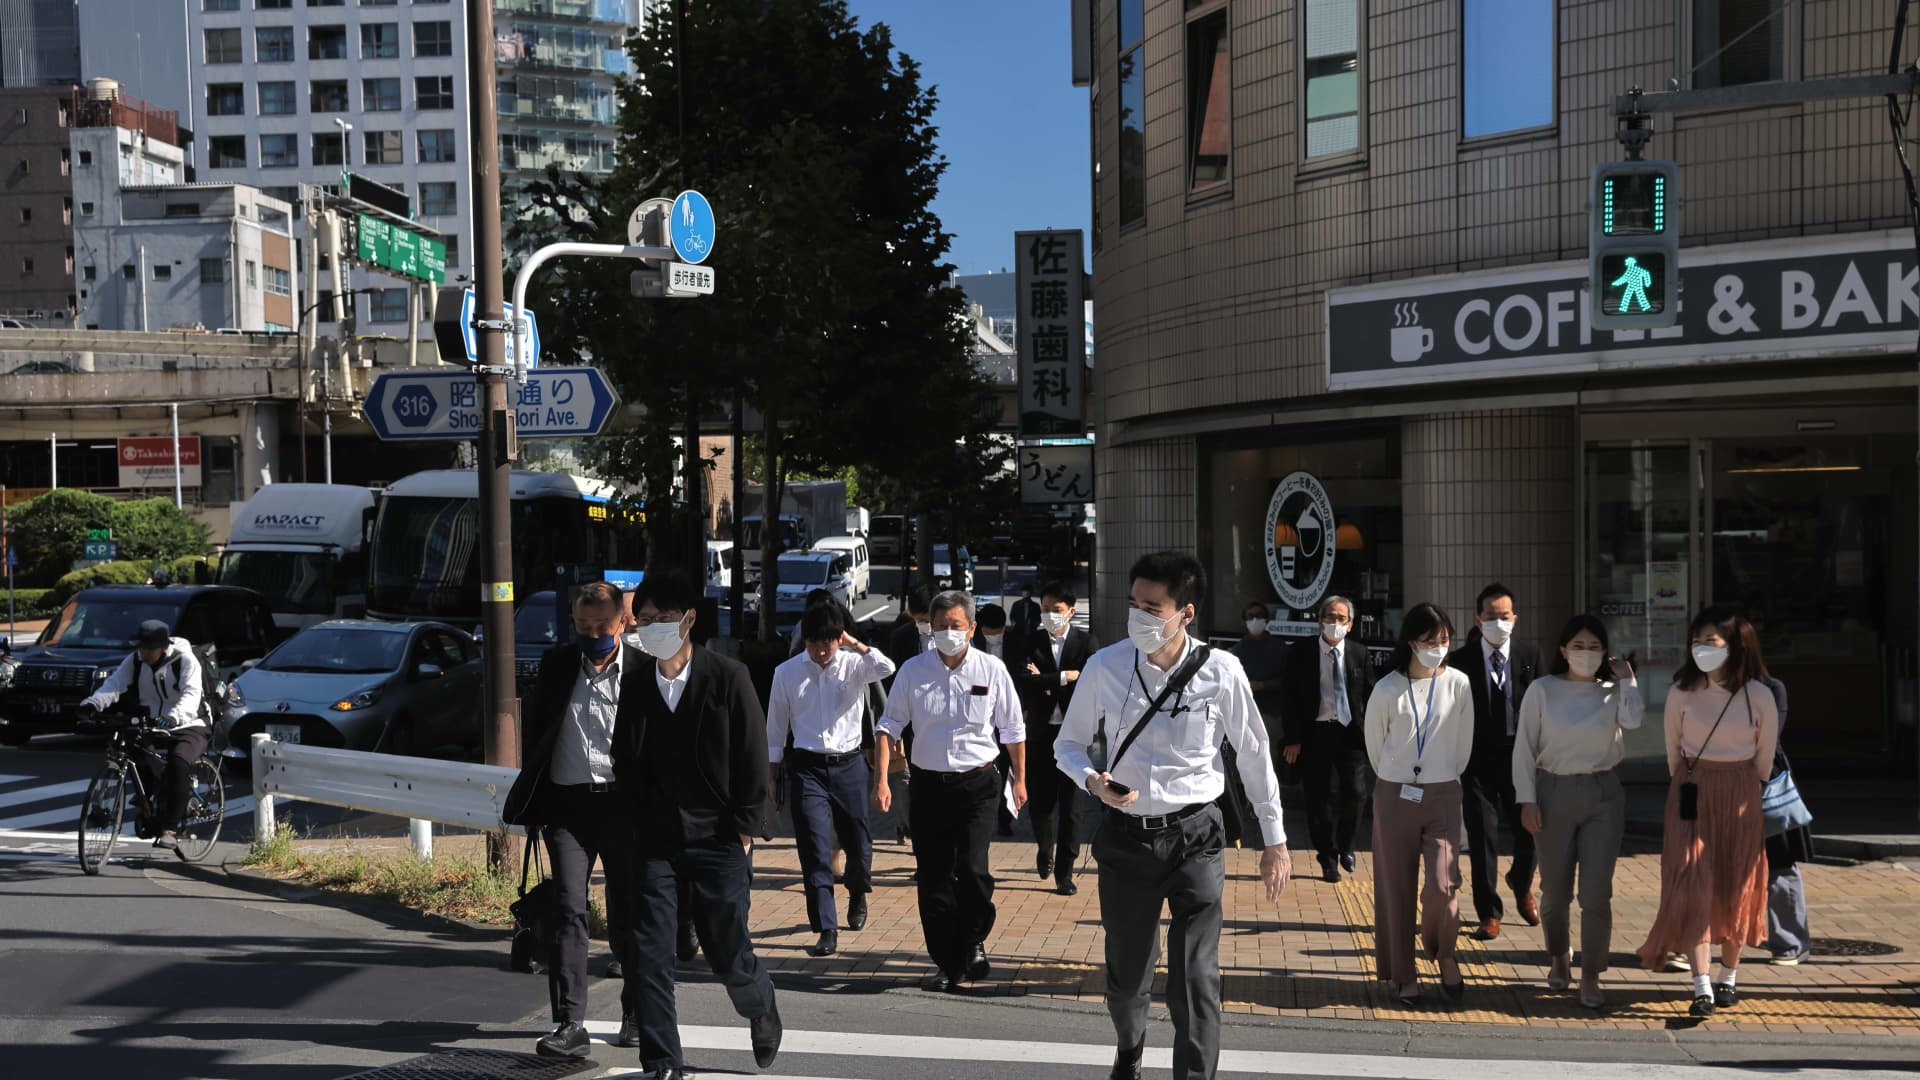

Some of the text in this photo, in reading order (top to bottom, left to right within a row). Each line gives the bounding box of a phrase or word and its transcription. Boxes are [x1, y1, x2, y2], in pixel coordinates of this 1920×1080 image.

[674, 270, 711, 288] 歩行者優先
[1029, 236, 1070, 407] 佐藤歯科
[1454, 286, 1683, 355] COF
[1707, 274, 1760, 335] &
[450, 379, 574, 407] 昭通り
[400, 394, 430, 417] 316
[449, 407, 579, 429] Shoori Ave.
[137, 448, 195, 460] Takashiaya
[1023, 452, 1090, 498] うどん
[255, 514, 326, 525] IMPACT
[1601, 604, 1644, 616] COFFEE
